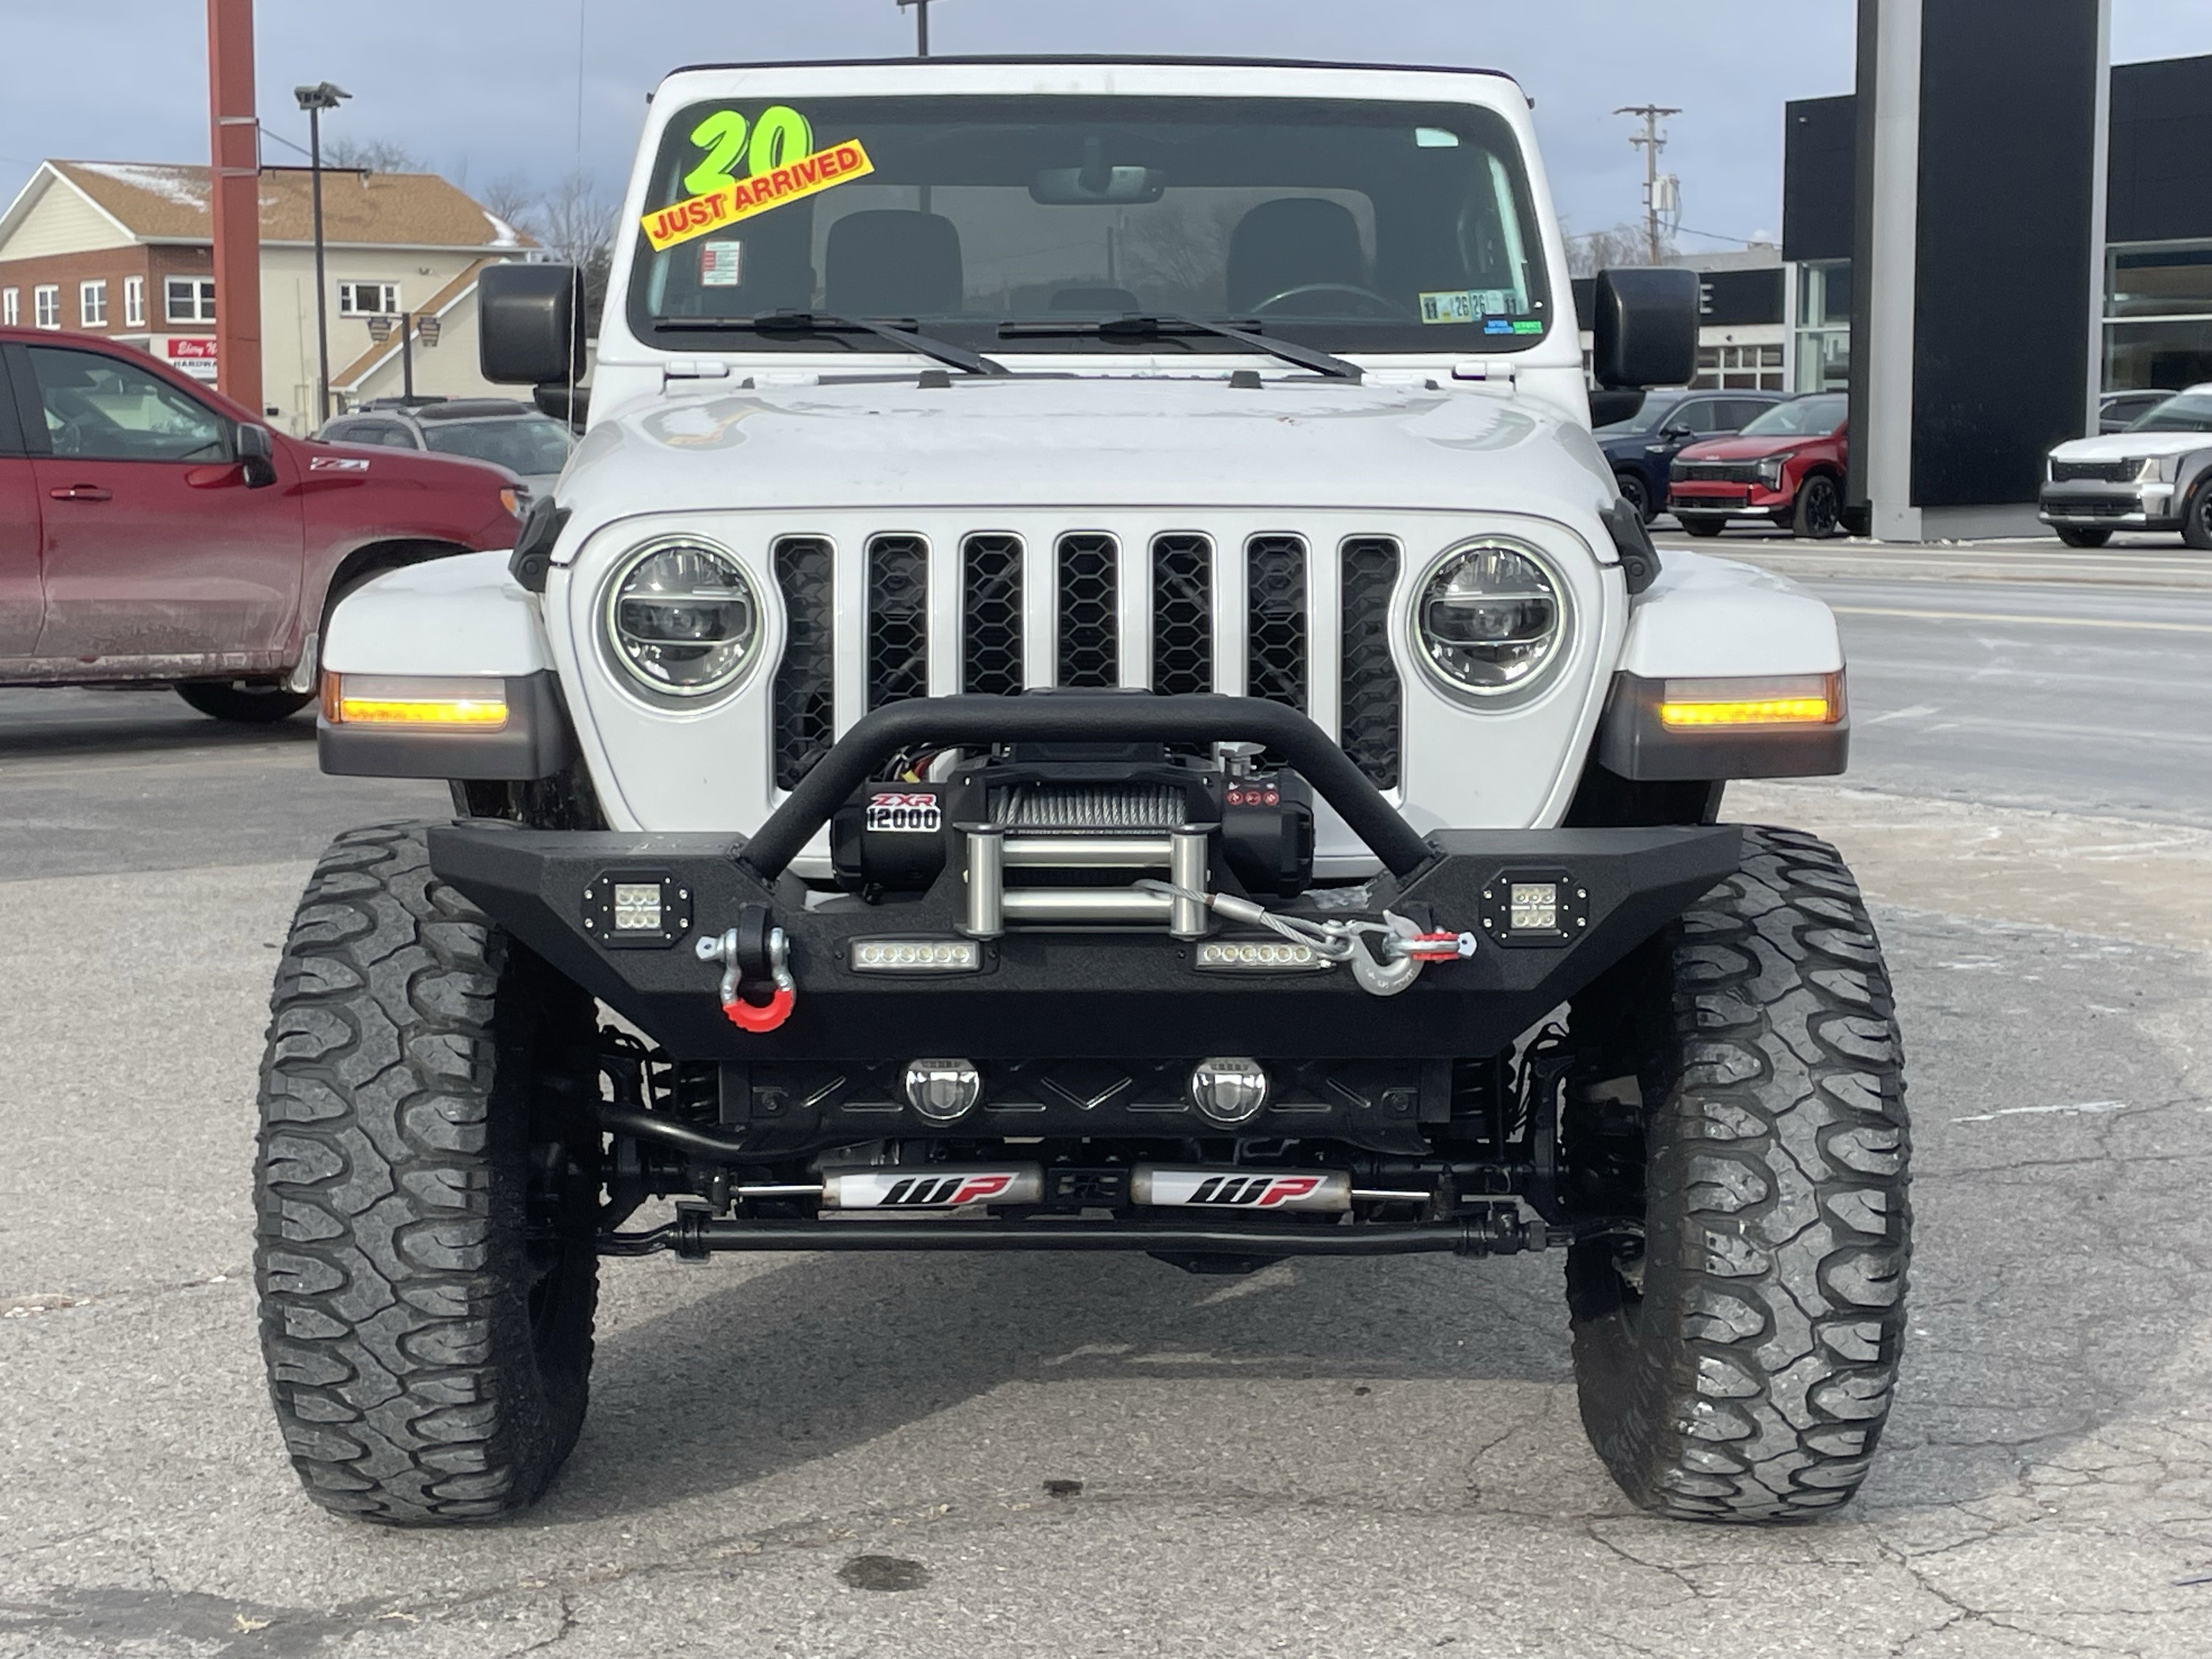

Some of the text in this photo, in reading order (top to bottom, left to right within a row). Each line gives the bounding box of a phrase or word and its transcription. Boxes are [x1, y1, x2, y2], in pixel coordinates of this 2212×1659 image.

[684, 105, 812, 196] 20
[653, 147, 861, 240] JUST ARRIVED
[868, 808, 938, 829] 12000
[871, 793, 934, 807] ZXR
